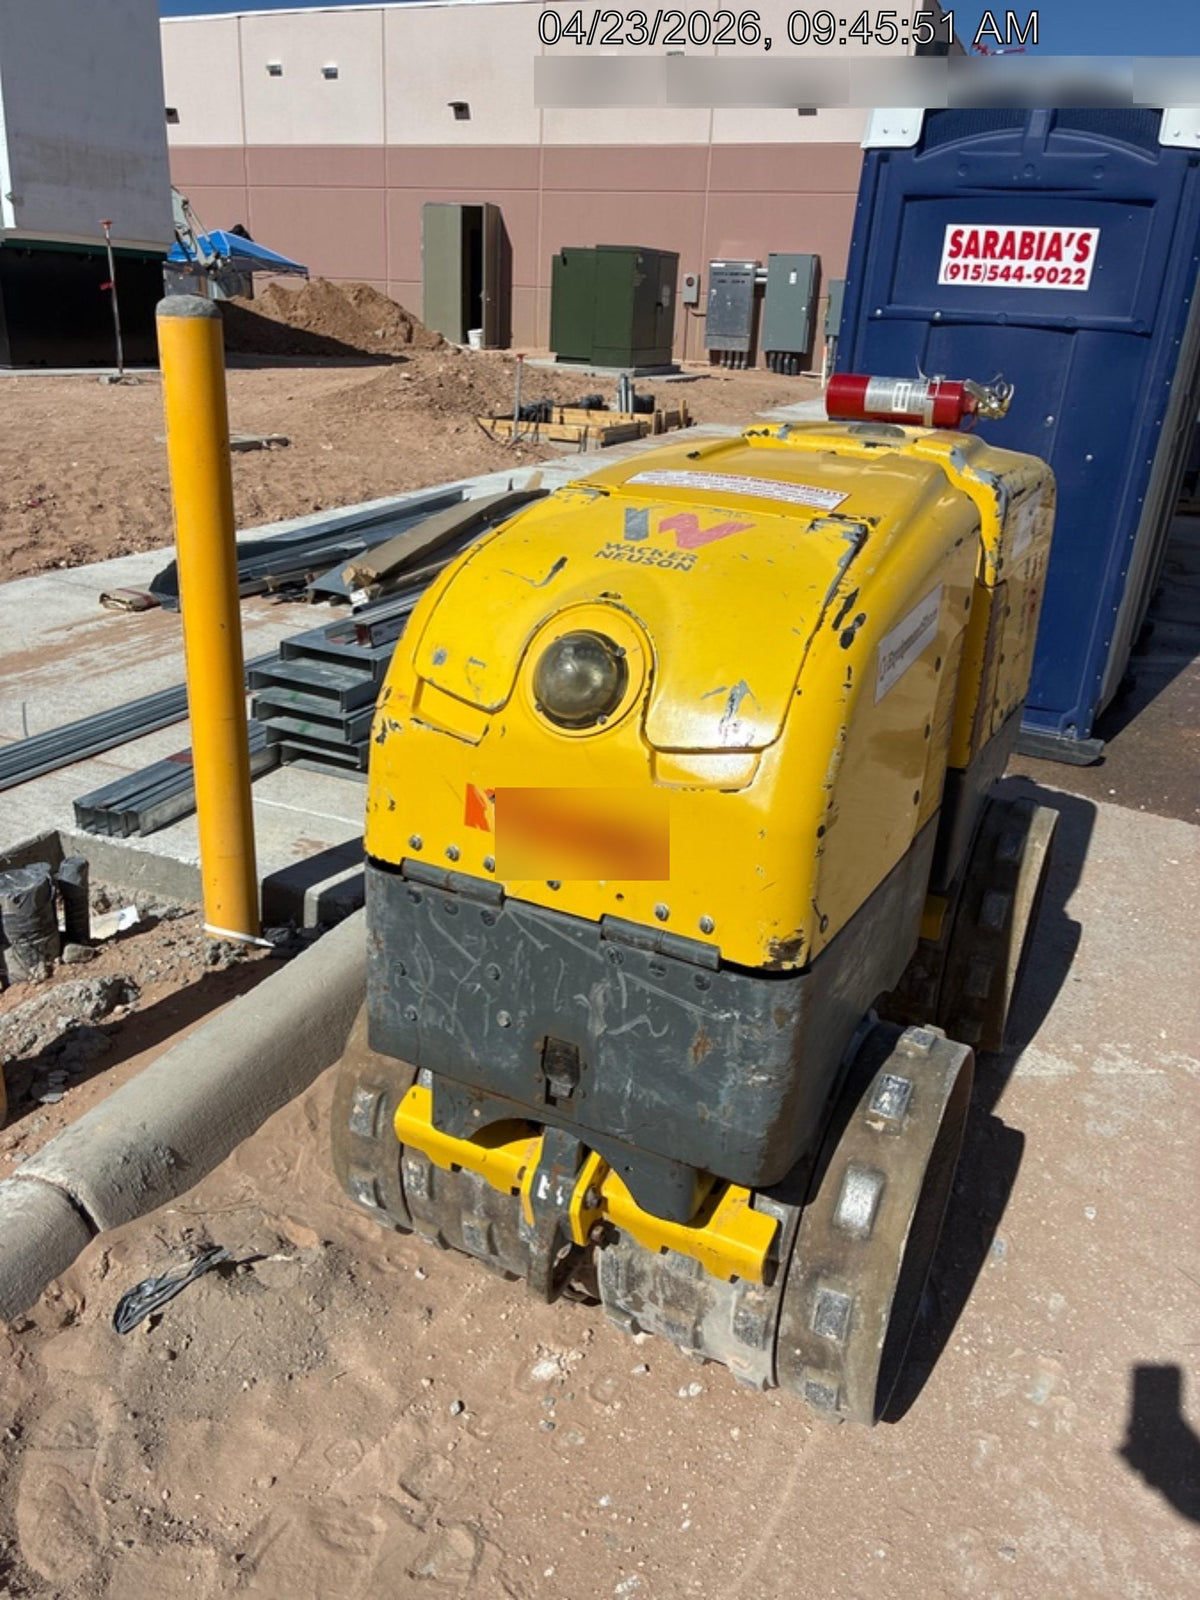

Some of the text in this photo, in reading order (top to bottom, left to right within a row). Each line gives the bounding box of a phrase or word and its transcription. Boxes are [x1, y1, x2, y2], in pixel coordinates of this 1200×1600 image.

[948, 229, 1092, 263] SARABIA'S
[944, 263, 1086, 285] (915)544-9022
[594, 550, 692, 571] NEUSON
[605, 541, 698, 564] WACKER
